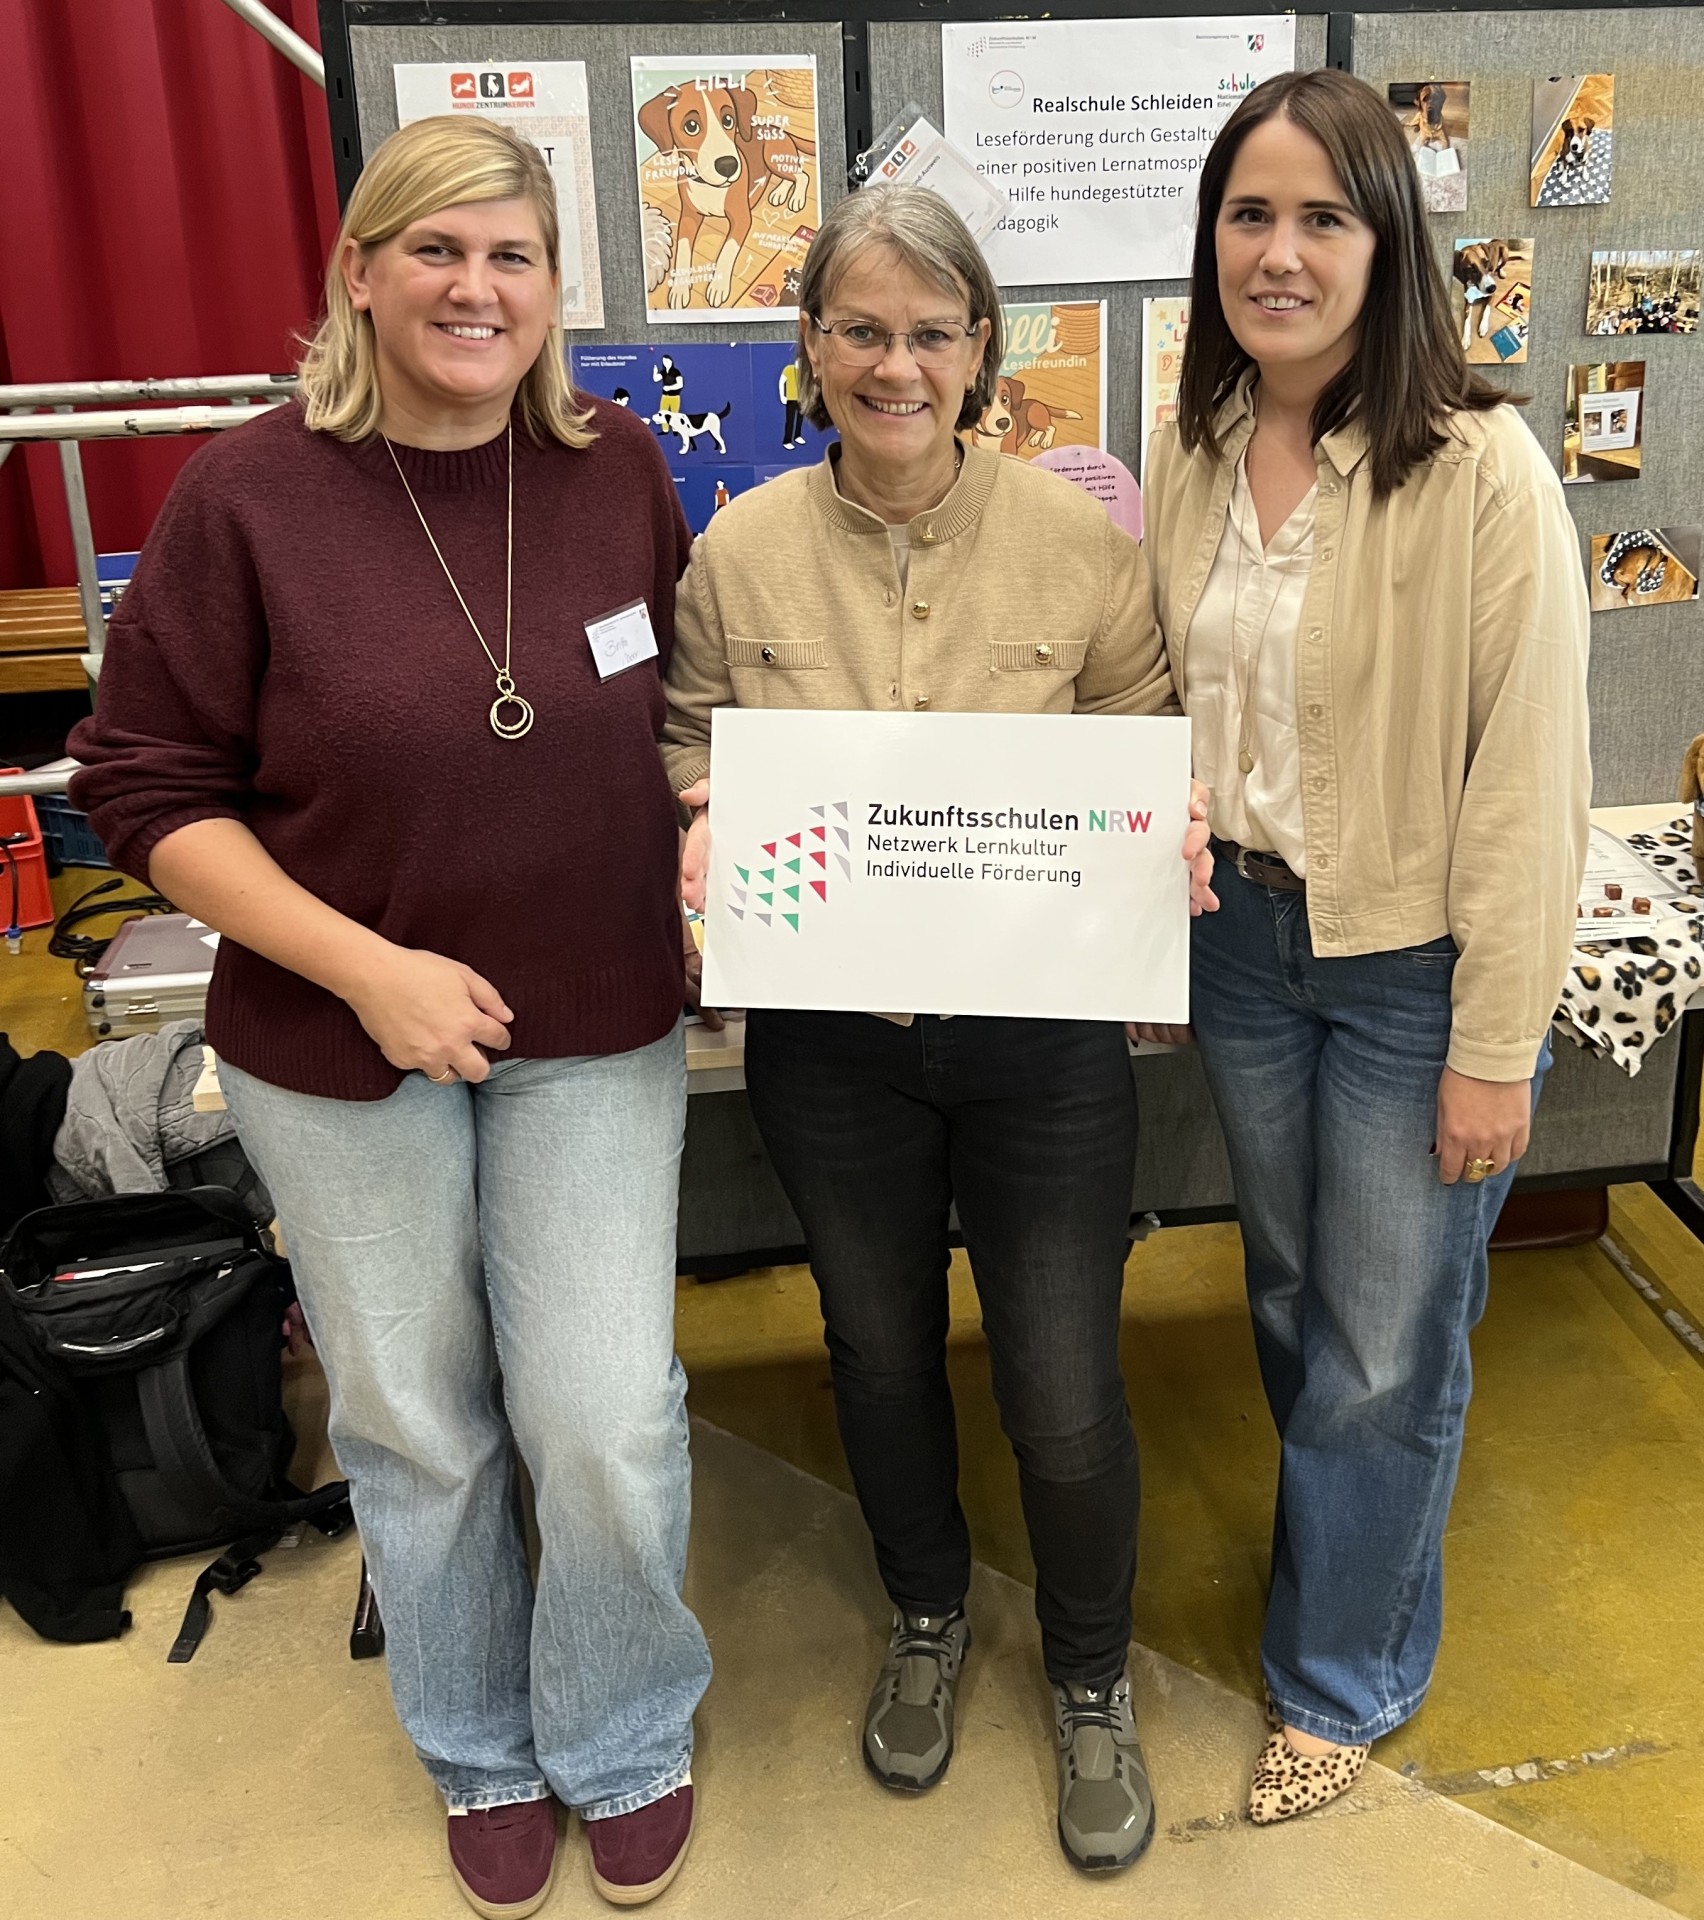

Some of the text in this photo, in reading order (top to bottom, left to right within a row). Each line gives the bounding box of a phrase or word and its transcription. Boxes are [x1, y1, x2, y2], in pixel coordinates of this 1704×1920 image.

[695, 74, 746, 92] LILLI
[1033, 93, 1213, 114] Realschule Schleiden
[751, 114, 790, 127] SUPER
[976, 126, 1218, 147] Leseförderung durch Gestaltu
[976, 154, 1206, 177] einer positiven Lernatmosph
[1009, 184, 1184, 203] Hilfe hundegestützter
[993, 214, 1060, 233] dagogik
[1003, 355, 1087, 371] Lesefreundin
[1085, 475, 1116, 483] positiven
[868, 804, 1152, 833] Zukunftsschulen NRW
[868, 834, 1068, 857] Netzwerk Lernkultur
[867, 860, 1081, 887] Individuelle Förderung
